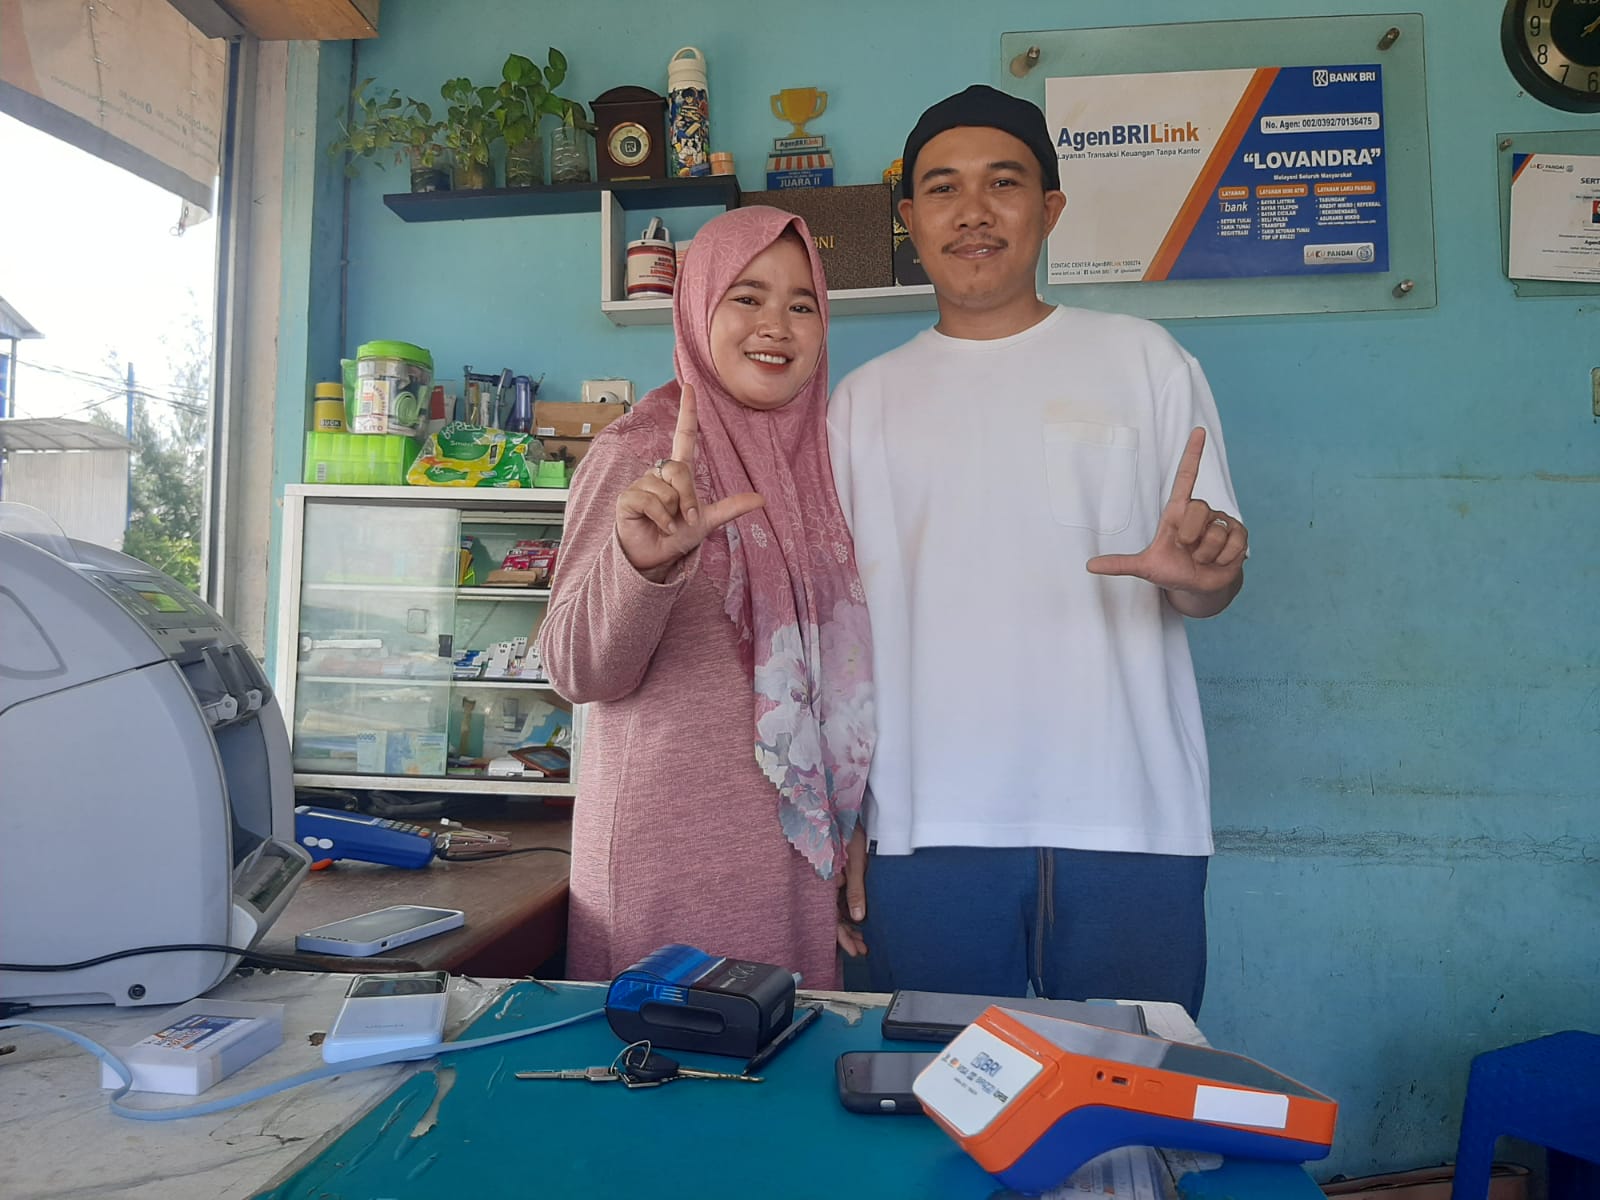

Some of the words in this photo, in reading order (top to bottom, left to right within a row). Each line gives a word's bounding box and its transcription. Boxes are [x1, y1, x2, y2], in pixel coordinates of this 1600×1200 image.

[1530, 15, 1540, 37] 9
[1537, 44, 1548, 65] 8
[1329, 72, 1358, 83] BANK
[1359, 71, 1376, 82] BRI
[1559, 64, 1570, 86] 7
[1588, 71, 1599, 93] 6
[1265, 120, 1278, 129] No.
[1279, 119, 1300, 131] Agen:
[1057, 121, 1199, 151] AgenBRILink
[1058, 152, 1086, 161] Layanan
[1087, 150, 1119, 159] Transaksi
[1121, 149, 1155, 158] Keuangan
[1156, 148, 1177, 156] Tanpa
[1178, 147, 1201, 155] Kantor
[780, 178, 811, 188] JUARA
[1219, 201, 1248, 213] Tbank
[980, 1058, 1002, 1077] BRI
